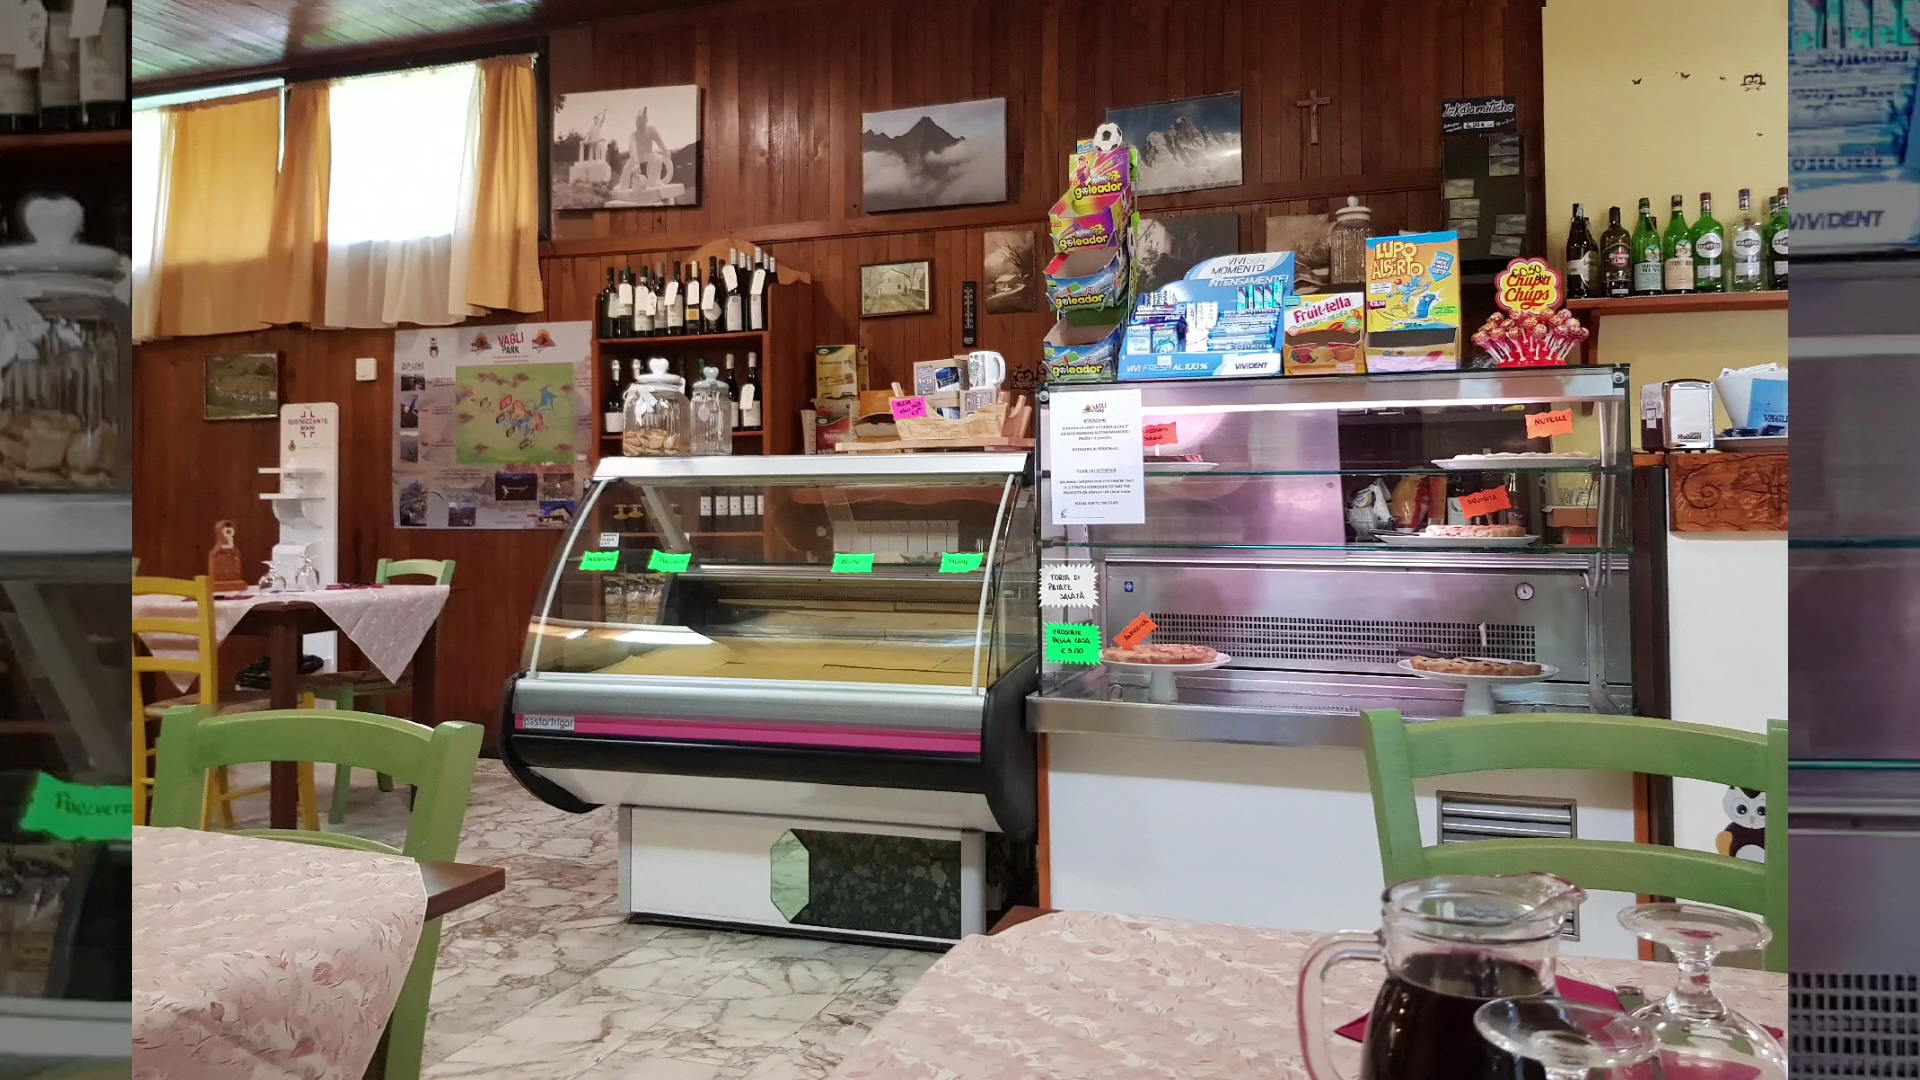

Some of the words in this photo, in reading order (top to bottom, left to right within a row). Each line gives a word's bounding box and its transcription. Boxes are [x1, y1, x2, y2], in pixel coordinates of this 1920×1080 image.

[1074, 181, 1123, 200] goleador
[1059, 235, 1109, 250] goleador
[1375, 240, 1418, 259] LUPO
[1228, 257, 1247, 265] VIVI
[1211, 264, 1265, 275] MOMENTO
[1370, 257, 1425, 281] ALBERTO
[1055, 293, 1105, 309] goleador
[1504, 287, 1550, 310] Chups
[1293, 296, 1353, 324] Fruit-tella
[498, 331, 525, 347] VAGLI
[502, 345, 520, 354] PARK
[1052, 364, 1103, 377] goleador
[1126, 364, 1141, 372] VIVI
[1234, 361, 1268, 370] VIVIDENT
[287, 418, 328, 426] IGIENIZZANTE
[1074, 637, 1091, 645] CASA
